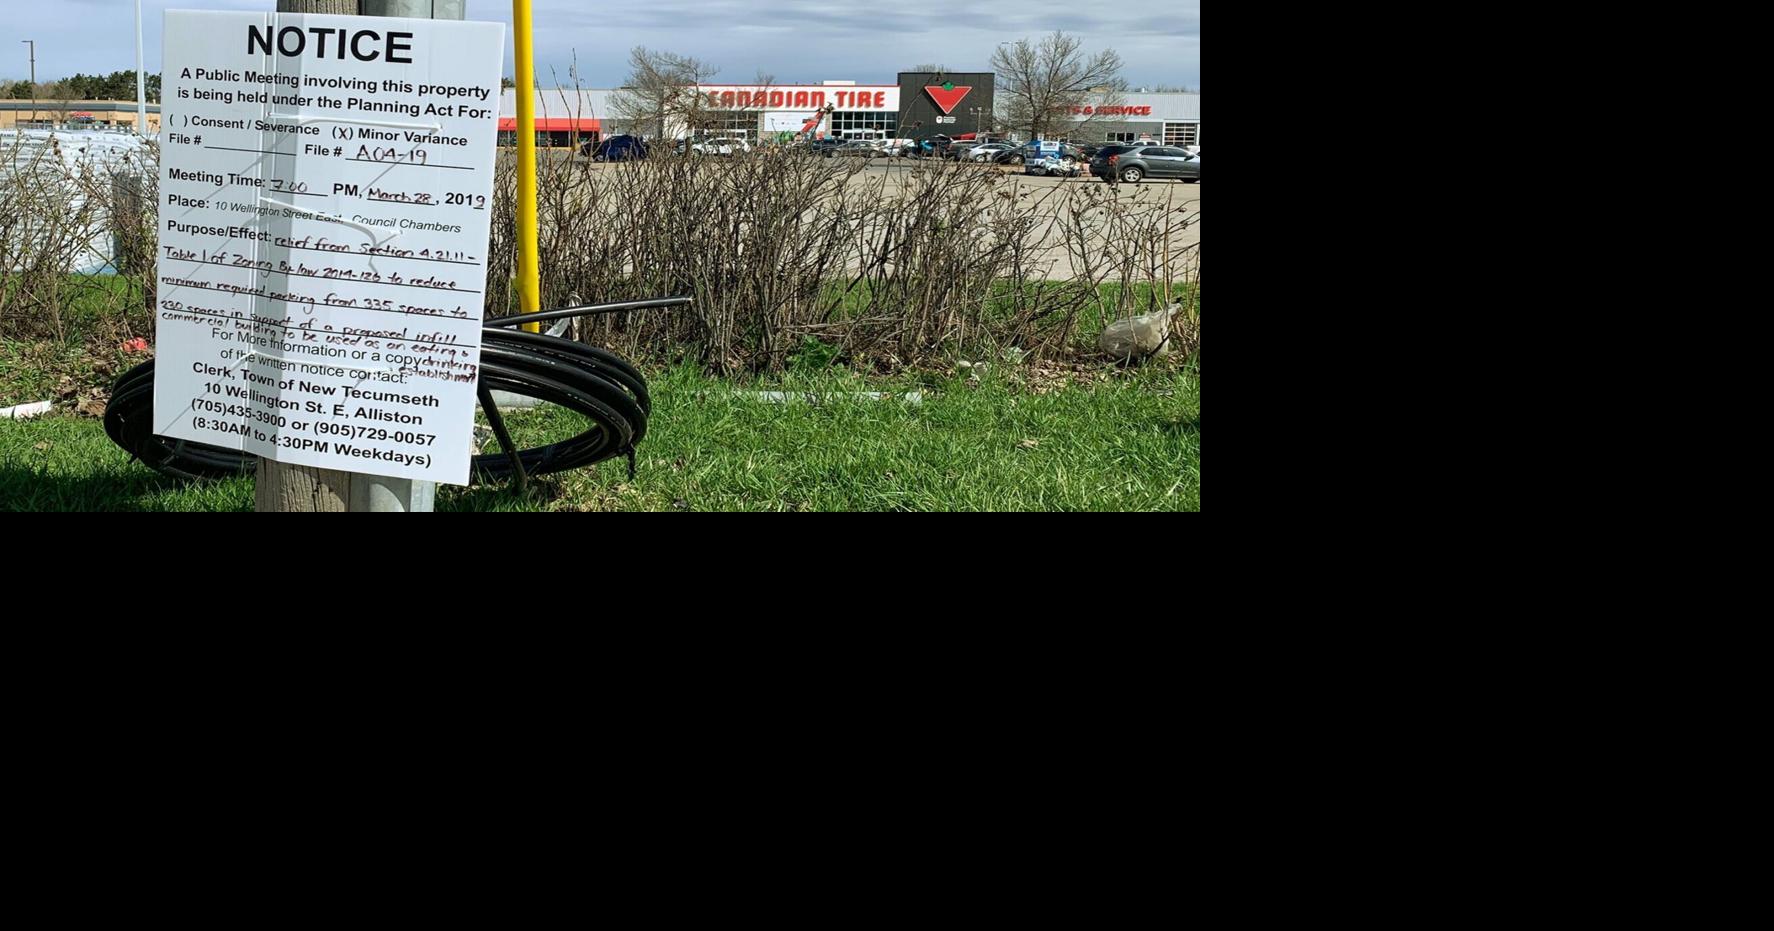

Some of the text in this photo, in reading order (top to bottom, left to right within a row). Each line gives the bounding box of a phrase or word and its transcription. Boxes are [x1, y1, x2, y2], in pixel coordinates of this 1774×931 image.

[247, 25, 413, 63] NOTICE
[180, 67, 490, 100] A Public Meeting involving this property
[708, 91, 886, 108] CANADIAN TIRE
[177, 87, 492, 119] is being held under the Planning Act For:
[169, 134, 202, 145] File #
[191, 116, 244, 129] Consent
[247, 120, 251, 129] /
[255, 120, 320, 135] Severance
[358, 128, 400, 141] Minor
[404, 131, 468, 146] Variance
[305, 144, 329, 156] File
[333, 147, 342, 156] #
[169, 168, 223, 186] Meeting
[228, 173, 266, 187] Time:
[333, 183, 362, 199] PM,
[368, 188, 411, 201] March
[445, 193, 485, 208] 2019
[168, 194, 209, 209] Place:
[215, 201, 227, 210] 10
[230, 204, 279, 216] Wellington
[282, 209, 316, 220] Street
[352, 214, 397, 227] Council
[400, 219, 461, 233] Chambers
[167, 220, 272, 242] Purpose/Effect:
[274, 236, 311, 248] relief
[315, 237, 350, 252] from
[360, 243, 414, 256] Section
[163, 246, 197, 260] Table
[210, 252, 227, 264] of
[232, 254, 272, 278] Zoning
[388, 272, 402, 284] to
[410, 276, 456, 289] reduce
[161, 276, 467, 317] minimum required parking from 335 spaces to
[161, 300, 183, 310] 230
[187, 305, 225, 316] spaces
[230, 308, 243, 318] in
[250, 313, 294, 327] support
[299, 318, 318, 329] of
[343, 326, 407, 339] proposed
[416, 332, 456, 344] infill
[162, 312, 229, 328] commercial
[235, 320, 276, 337] building
[280, 327, 295, 339] to
[303, 330, 318, 341] be
[326, 335, 361, 346] used
[365, 340, 379, 349] as
[386, 343, 405, 351] an
[411, 344, 455, 359] eating
[212, 328, 422, 366] For More Information or a copy
[220, 349, 233, 359] of
[236, 350, 255, 363] the
[258, 356, 296, 372] written
[301, 364, 344, 377] notice
[421, 356, 477, 372] drinking
[193, 362, 439, 407] Clerk, Town of New Tecumseth
[191, 398, 436, 446] (705)435-3900 or (905)729-0057
[205, 383, 423, 425] 10 Wellington St. E, Alliston
[193, 417, 431, 468] (8:30AM to 4:30PM Weekdays)
